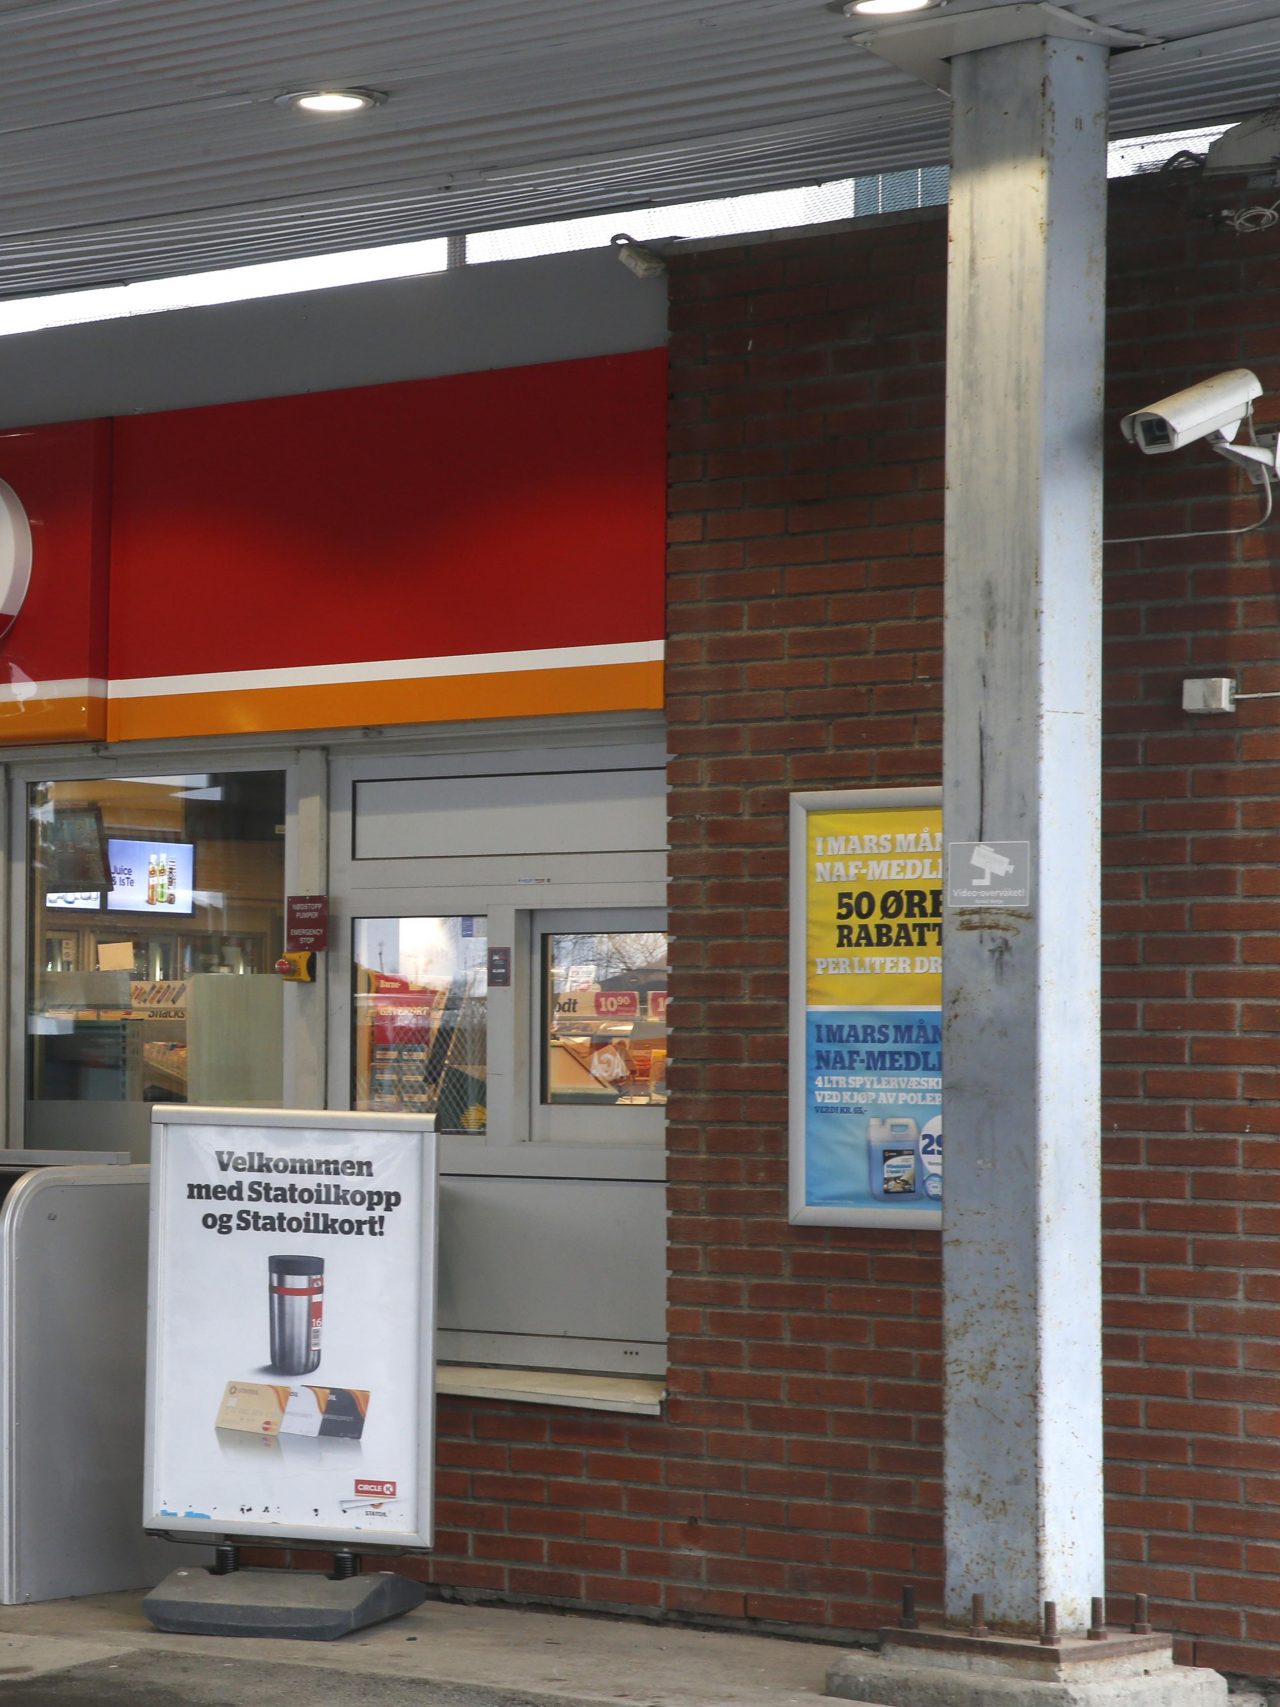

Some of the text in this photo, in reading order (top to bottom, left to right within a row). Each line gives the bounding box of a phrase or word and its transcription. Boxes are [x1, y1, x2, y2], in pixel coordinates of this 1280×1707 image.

[815, 836, 824, 856] I
[826, 833, 892, 855] MARS
[111, 865, 133, 876] Juice
[815, 858, 942, 882] NAF-MEDL
[836, 891, 875, 920] 50
[815, 957, 851, 975] PER
[852, 956, 912, 974] LITER
[815, 1024, 823, 1043] I
[825, 1024, 890, 1043] MARS
[815, 1050, 942, 1071] NAF-MEDL
[814, 1091, 840, 1103] VED
[877, 1092, 898, 1104] AV
[214, 1150, 374, 1178] Velkommen
[186, 1181, 402, 1212] med Statoilkopp
[201, 1209, 386, 1237] og Statoilkort!
